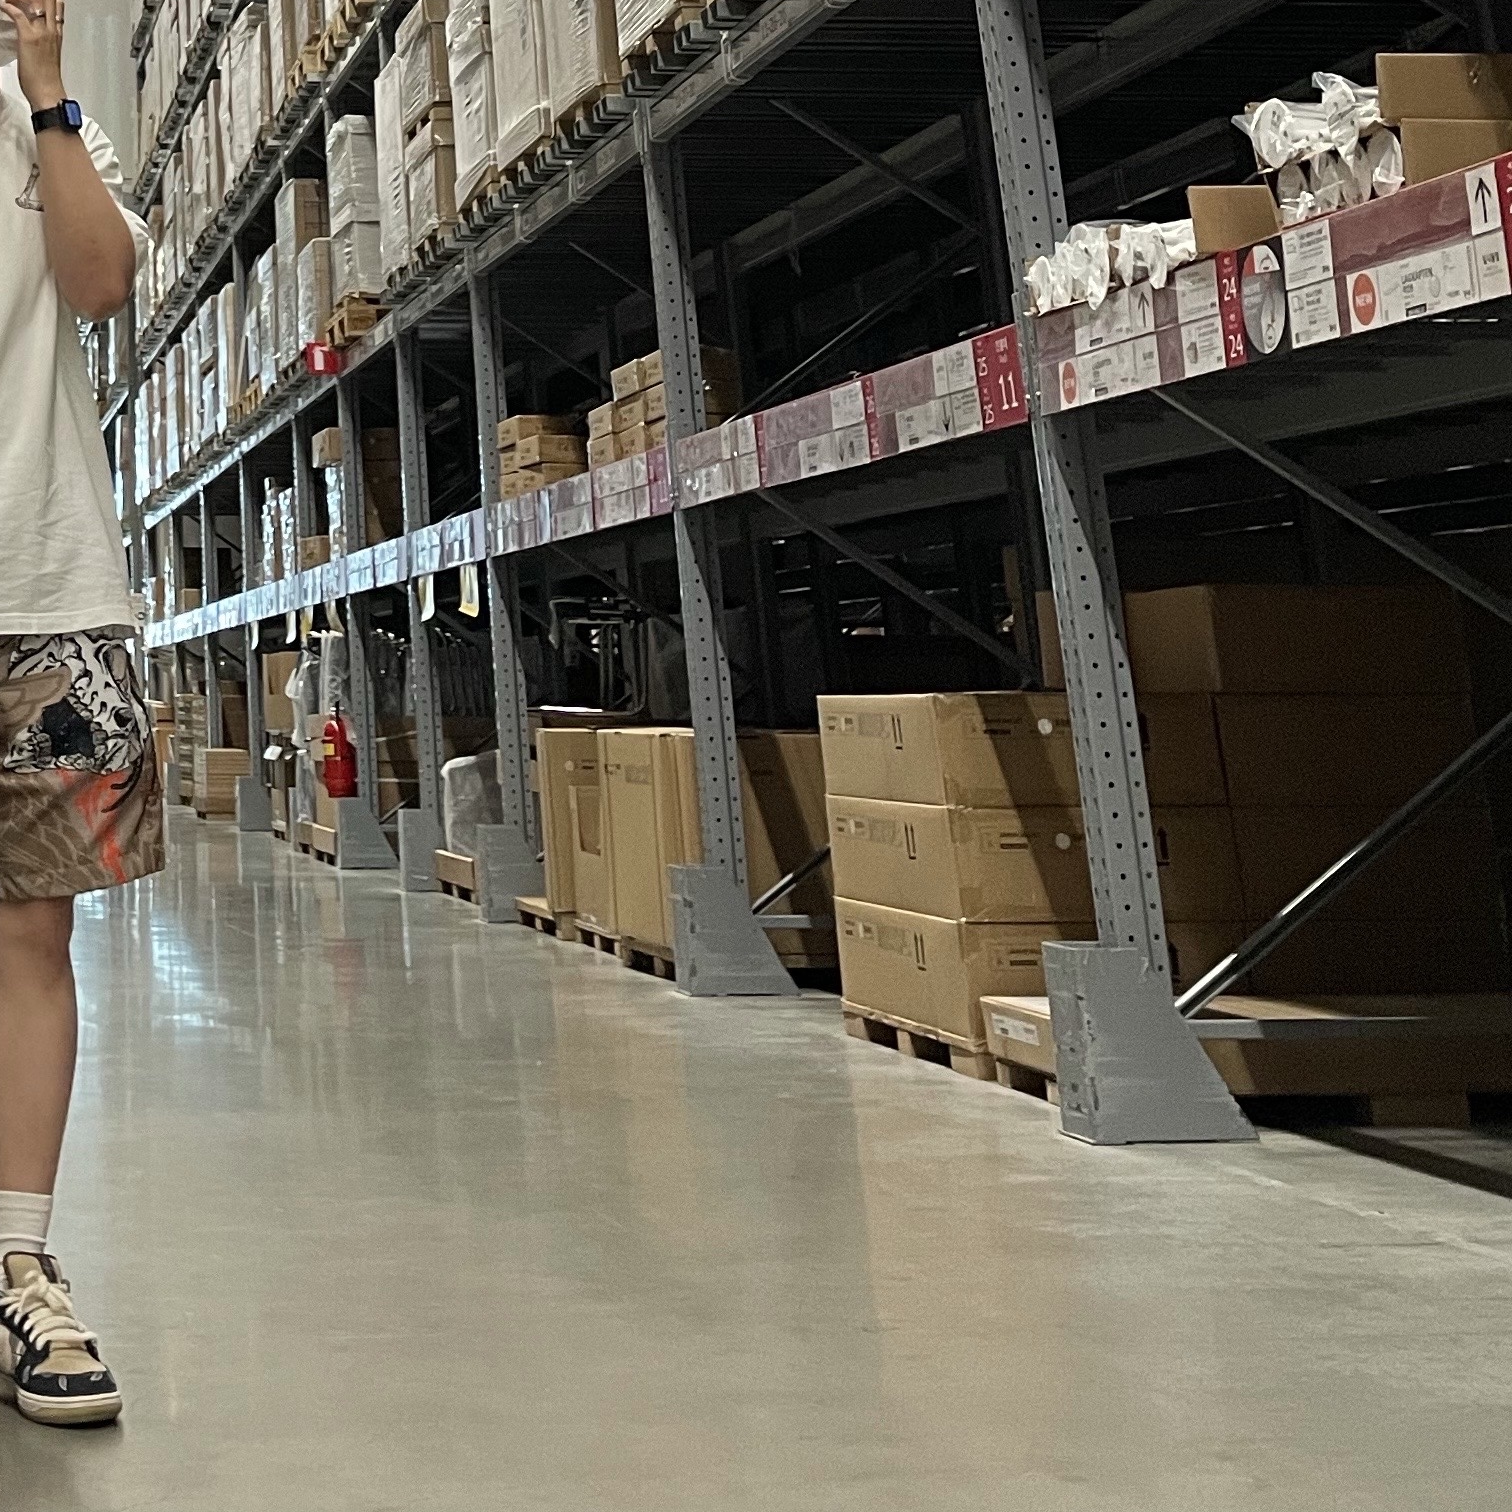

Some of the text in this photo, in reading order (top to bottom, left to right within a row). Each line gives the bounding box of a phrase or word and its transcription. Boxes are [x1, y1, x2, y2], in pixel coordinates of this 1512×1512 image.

[1222, 276, 1237, 301] 24
[1228, 333, 1244, 358] 24
[998, 371, 1019, 410] 11
